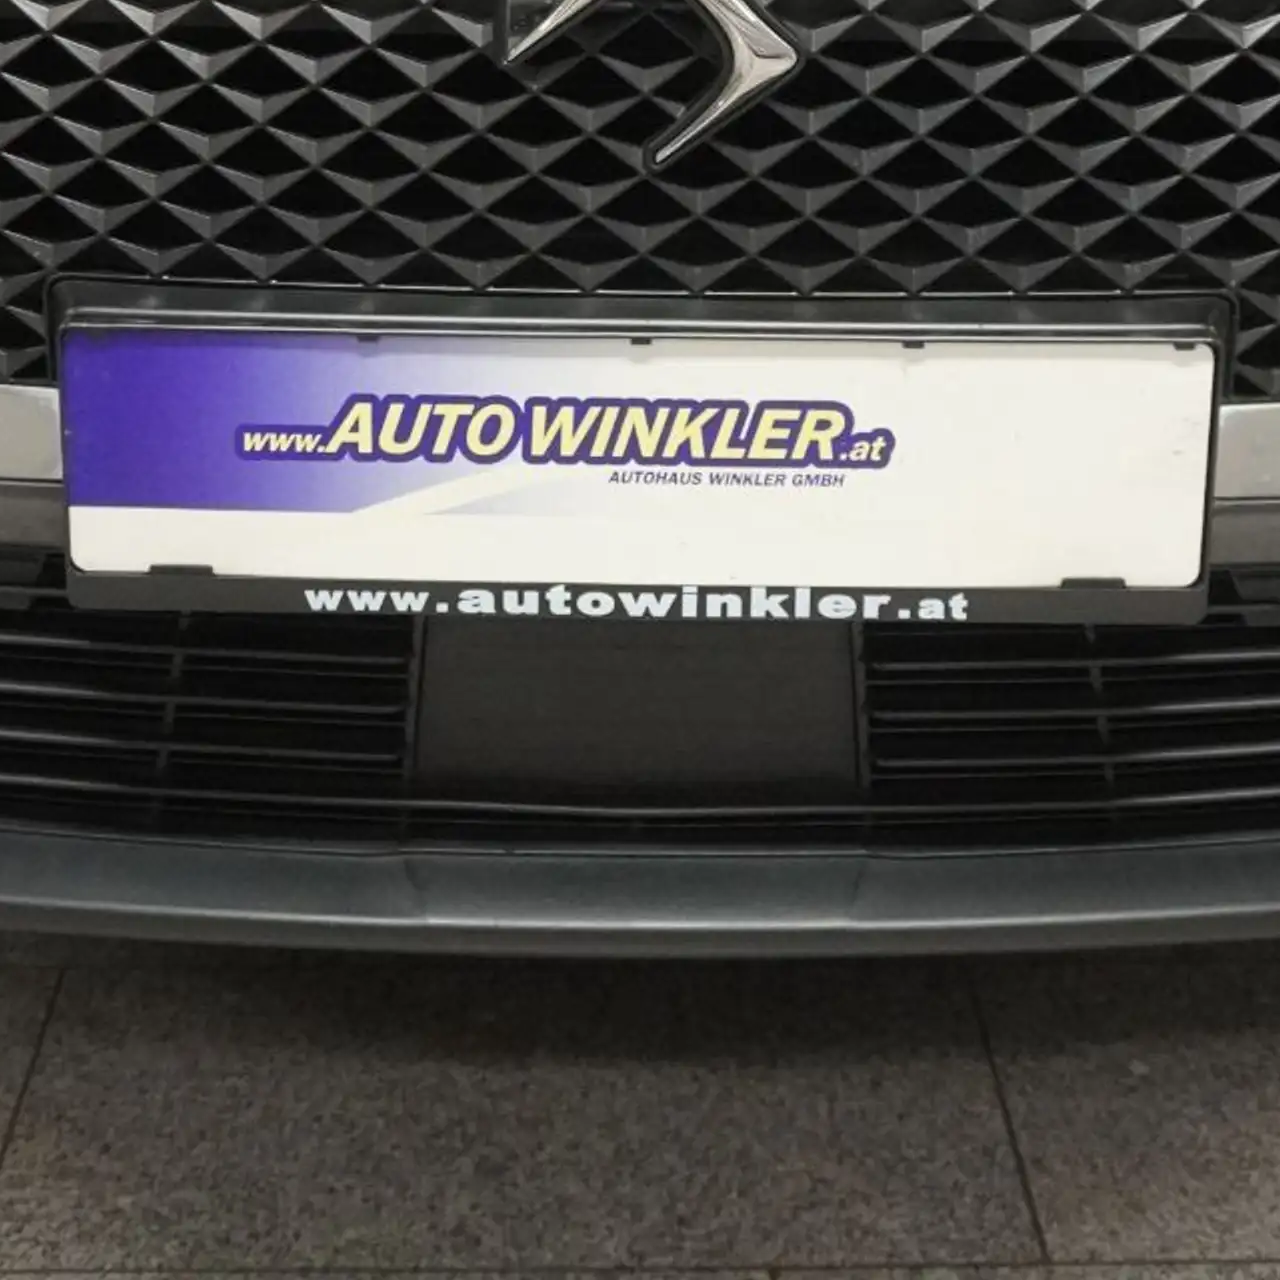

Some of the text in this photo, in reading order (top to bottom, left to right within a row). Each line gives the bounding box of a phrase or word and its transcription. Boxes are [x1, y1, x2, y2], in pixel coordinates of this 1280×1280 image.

[608, 470, 846, 488] AUTOHAUS WINKLER GMBH
[304, 586, 969, 620] www.autowinkler.at
